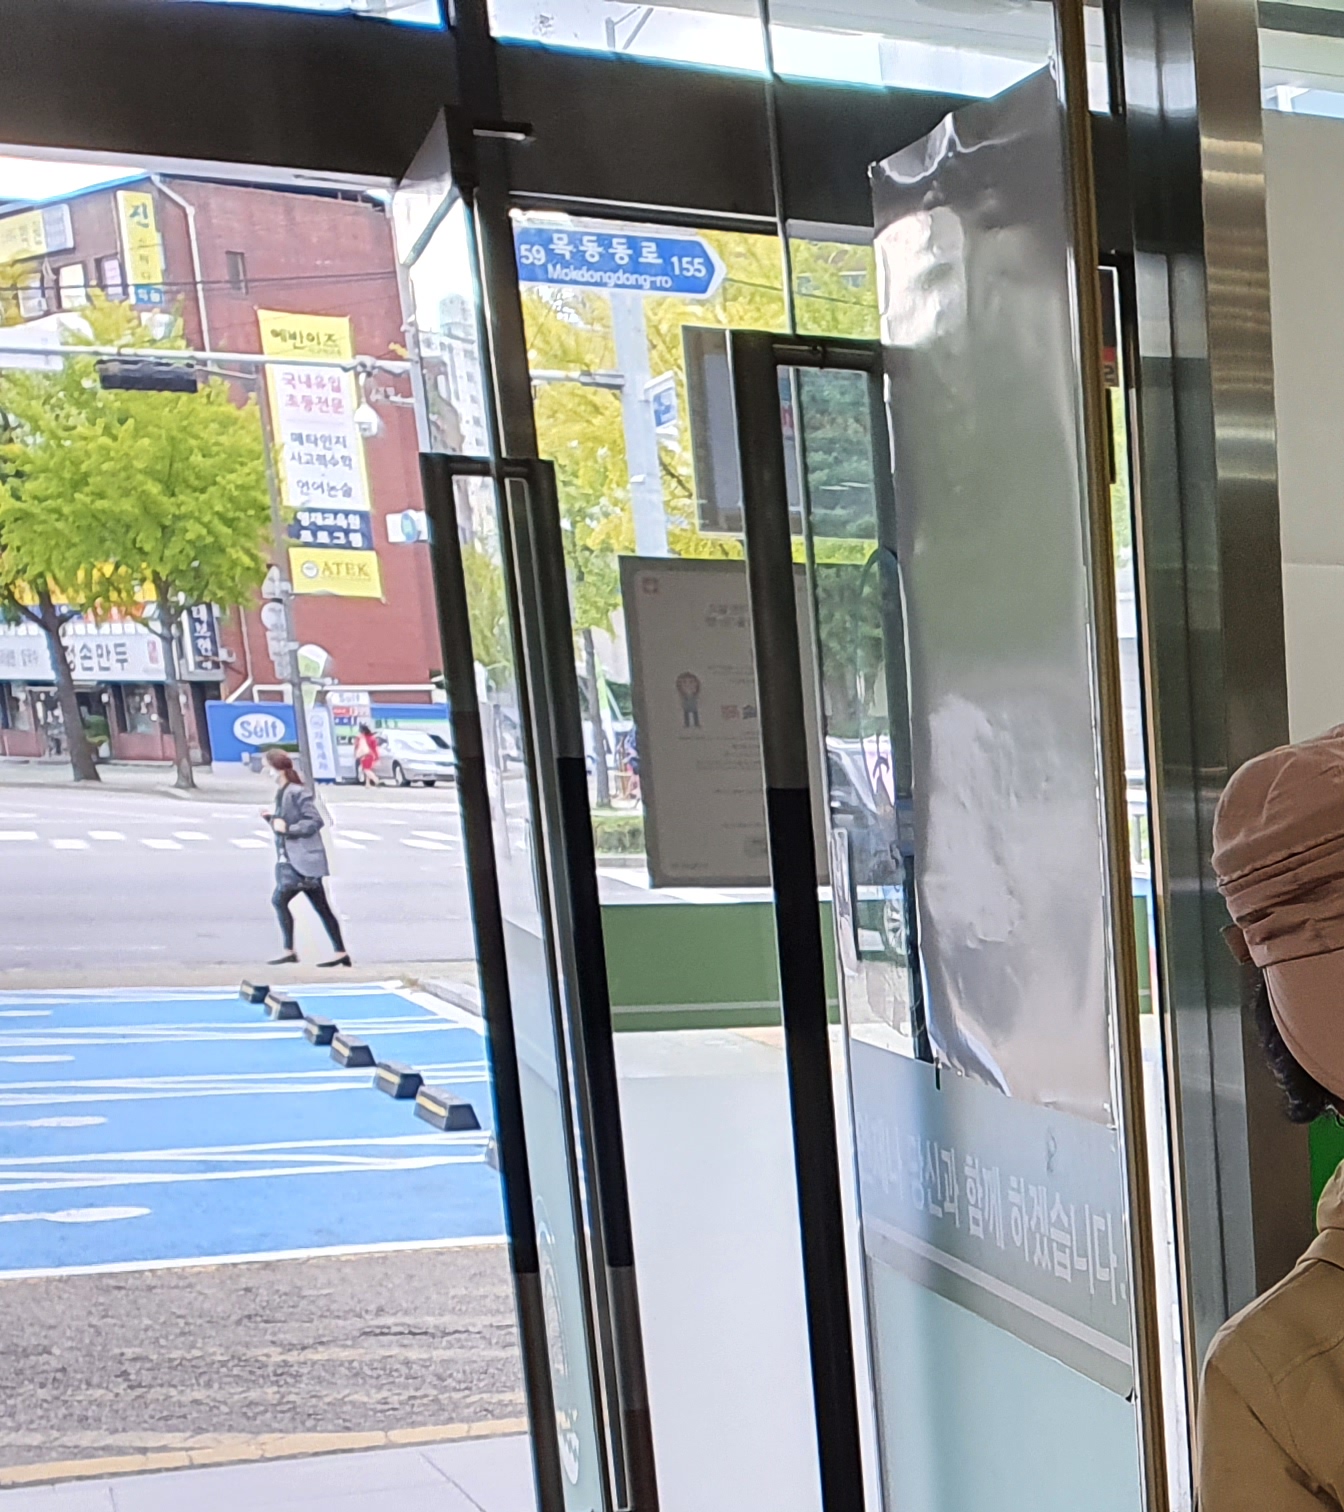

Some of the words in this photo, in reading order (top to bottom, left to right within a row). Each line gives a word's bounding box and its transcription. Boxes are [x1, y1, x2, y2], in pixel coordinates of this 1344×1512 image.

[519, 244, 546, 265] 59
[549, 233, 663, 265] 목동동로
[670, 256, 707, 277] 155
[547, 263, 673, 289] Mokdongdong-ro
[296, 479, 353, 498] 언어논술
[239, 715, 279, 739] Self
[964, 1154, 1004, 1249] 함께
[1008, 1175, 1127, 1306] 하겠습니다.
